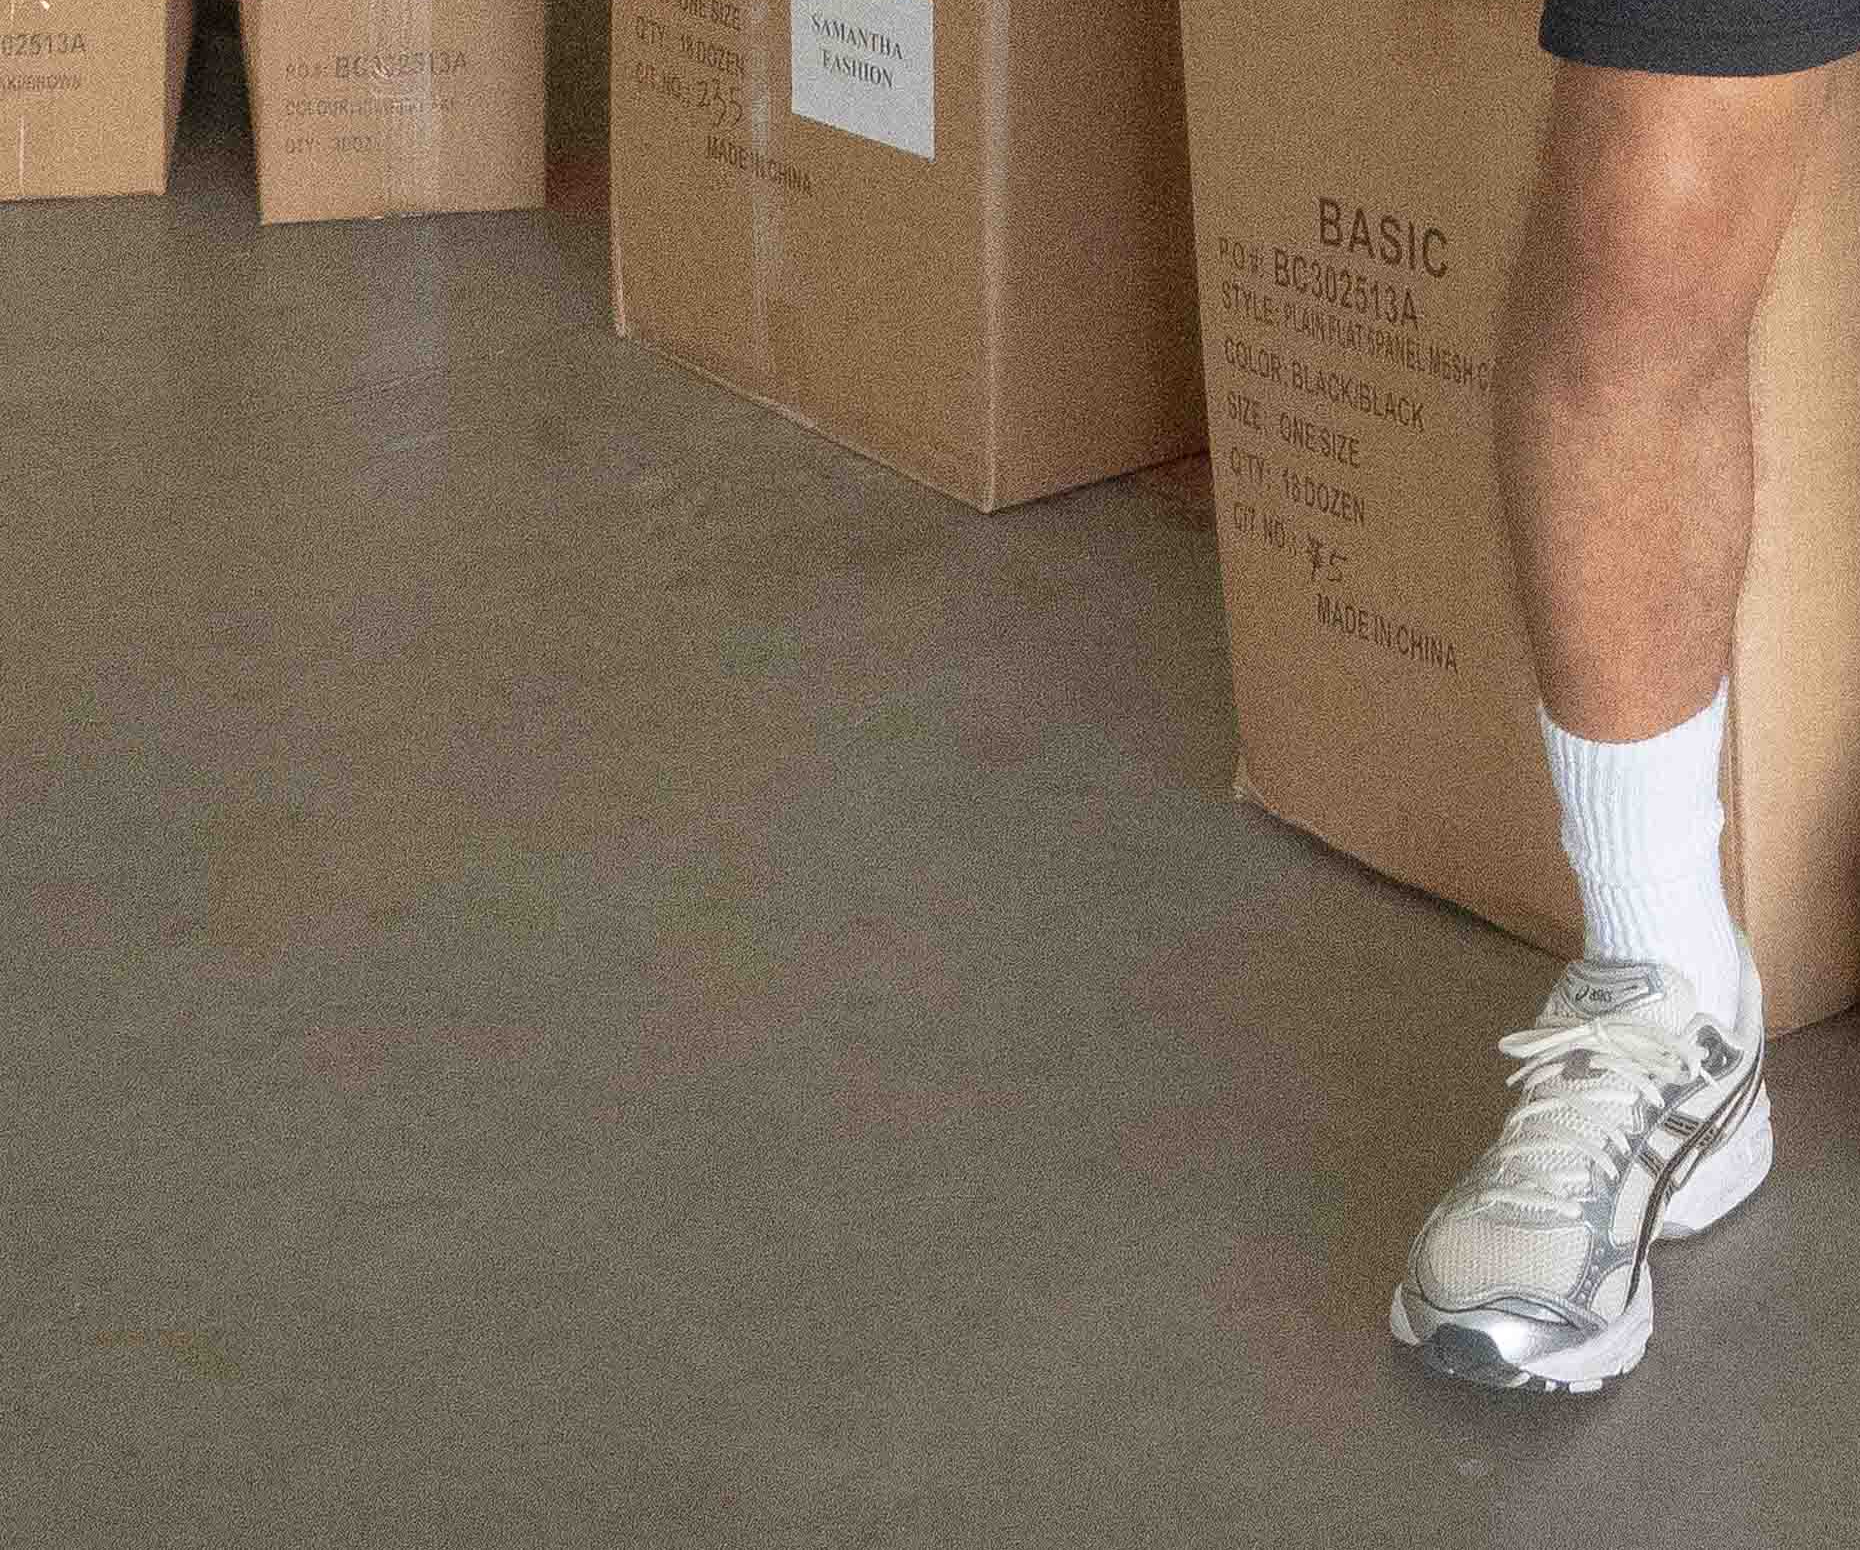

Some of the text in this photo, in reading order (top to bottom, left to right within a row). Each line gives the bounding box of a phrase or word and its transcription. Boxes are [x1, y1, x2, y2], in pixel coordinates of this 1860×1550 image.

[811, 13, 903, 60] SAMANTHA
[822, 50, 894, 88] FASHION
[1319, 197, 1449, 278] BASIC
[1273, 247, 1419, 331] BC302513A
[1279, 411, 1315, 453] ONE
[1319, 426, 1362, 470] SIZE
[1304, 475, 1366, 529] DOZEN
[1315, 591, 1460, 675] MADE IN CHINA
